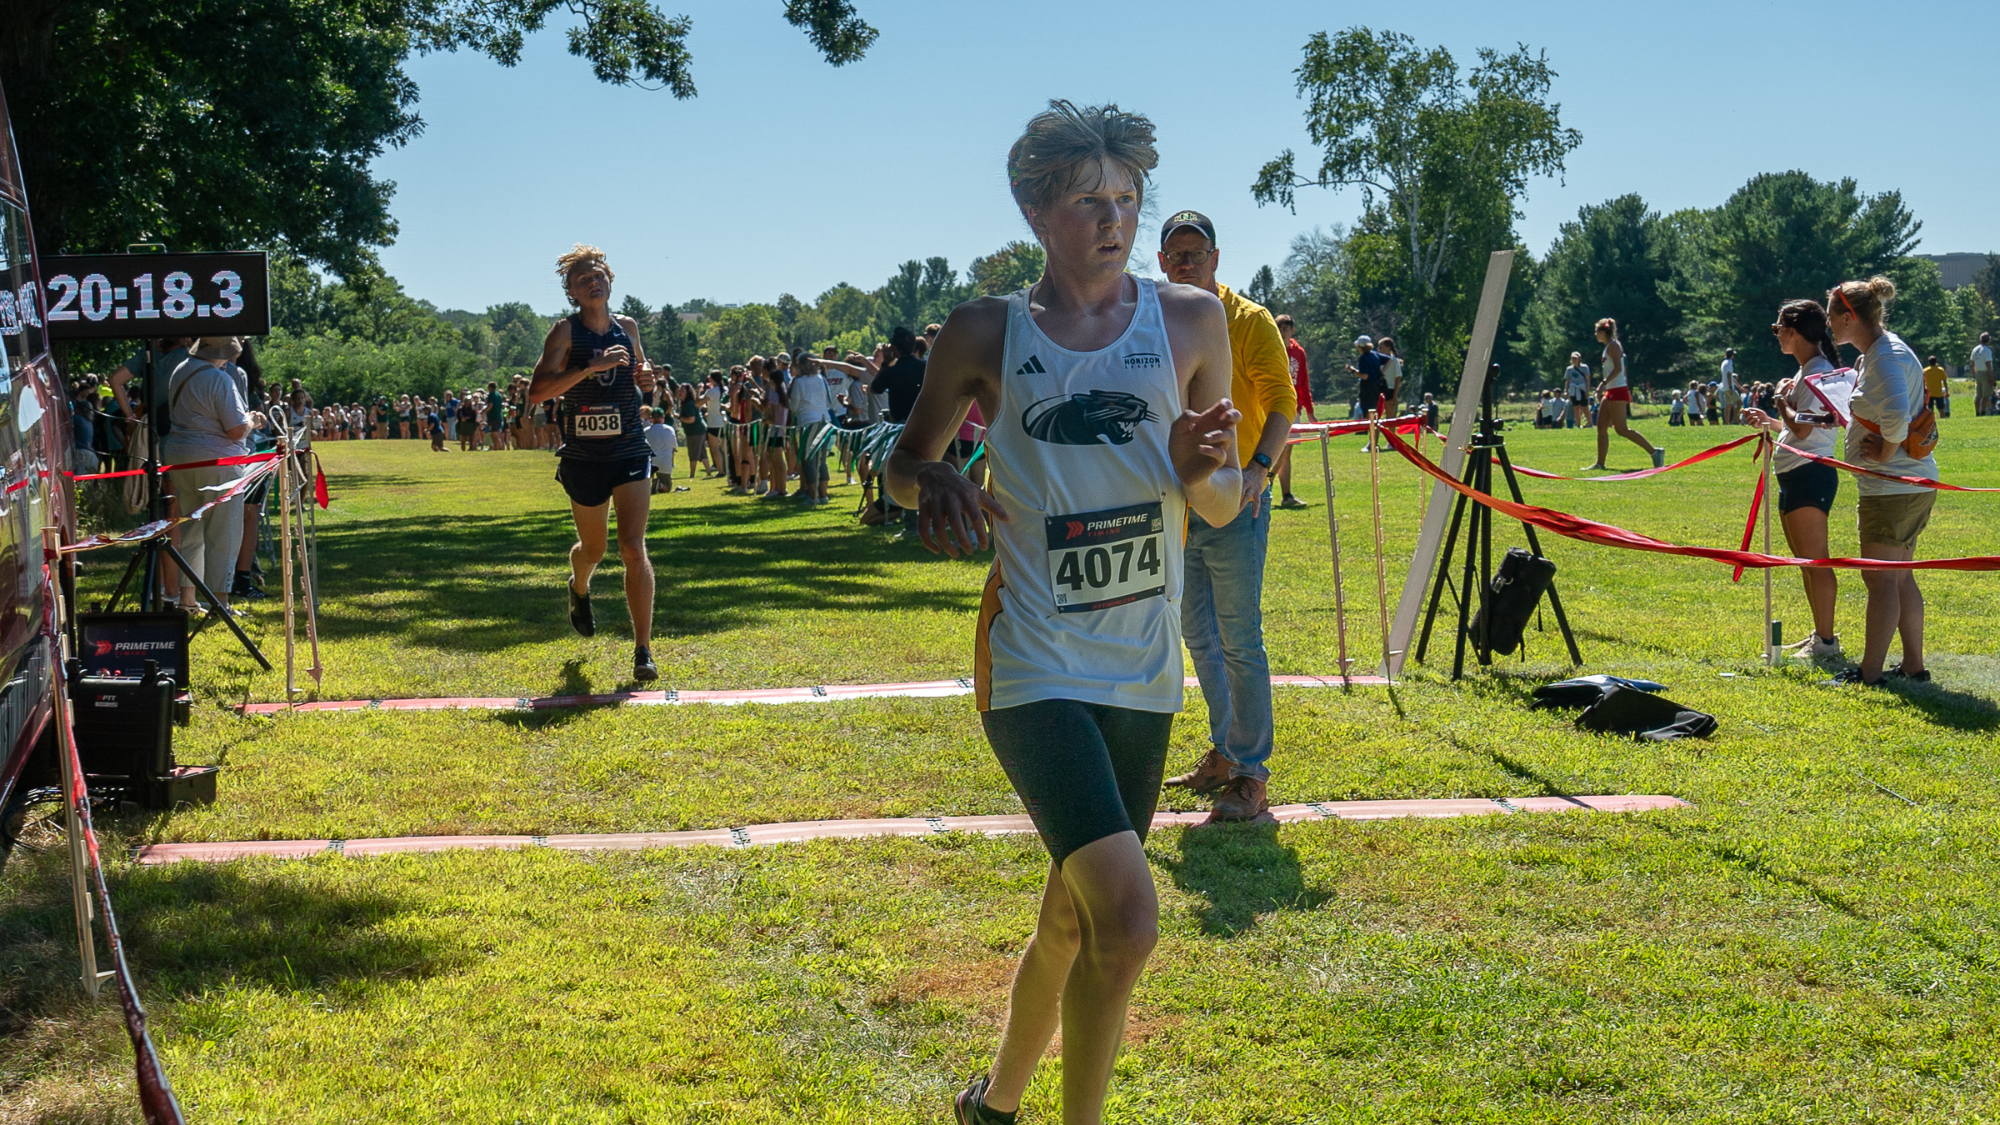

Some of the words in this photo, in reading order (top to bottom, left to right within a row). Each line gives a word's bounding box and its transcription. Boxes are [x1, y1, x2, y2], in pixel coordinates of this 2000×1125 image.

[47, 270, 244, 322] 20:18.3
[1124, 357, 1160, 365] HORIZON
[578, 415, 619, 431] 4038
[1087, 513, 1148, 531] PRIMETIME
[1087, 528, 1121, 538] TIMING
[1056, 537, 1161, 591] 4074
[115, 641, 175, 650] PRIMETIME
